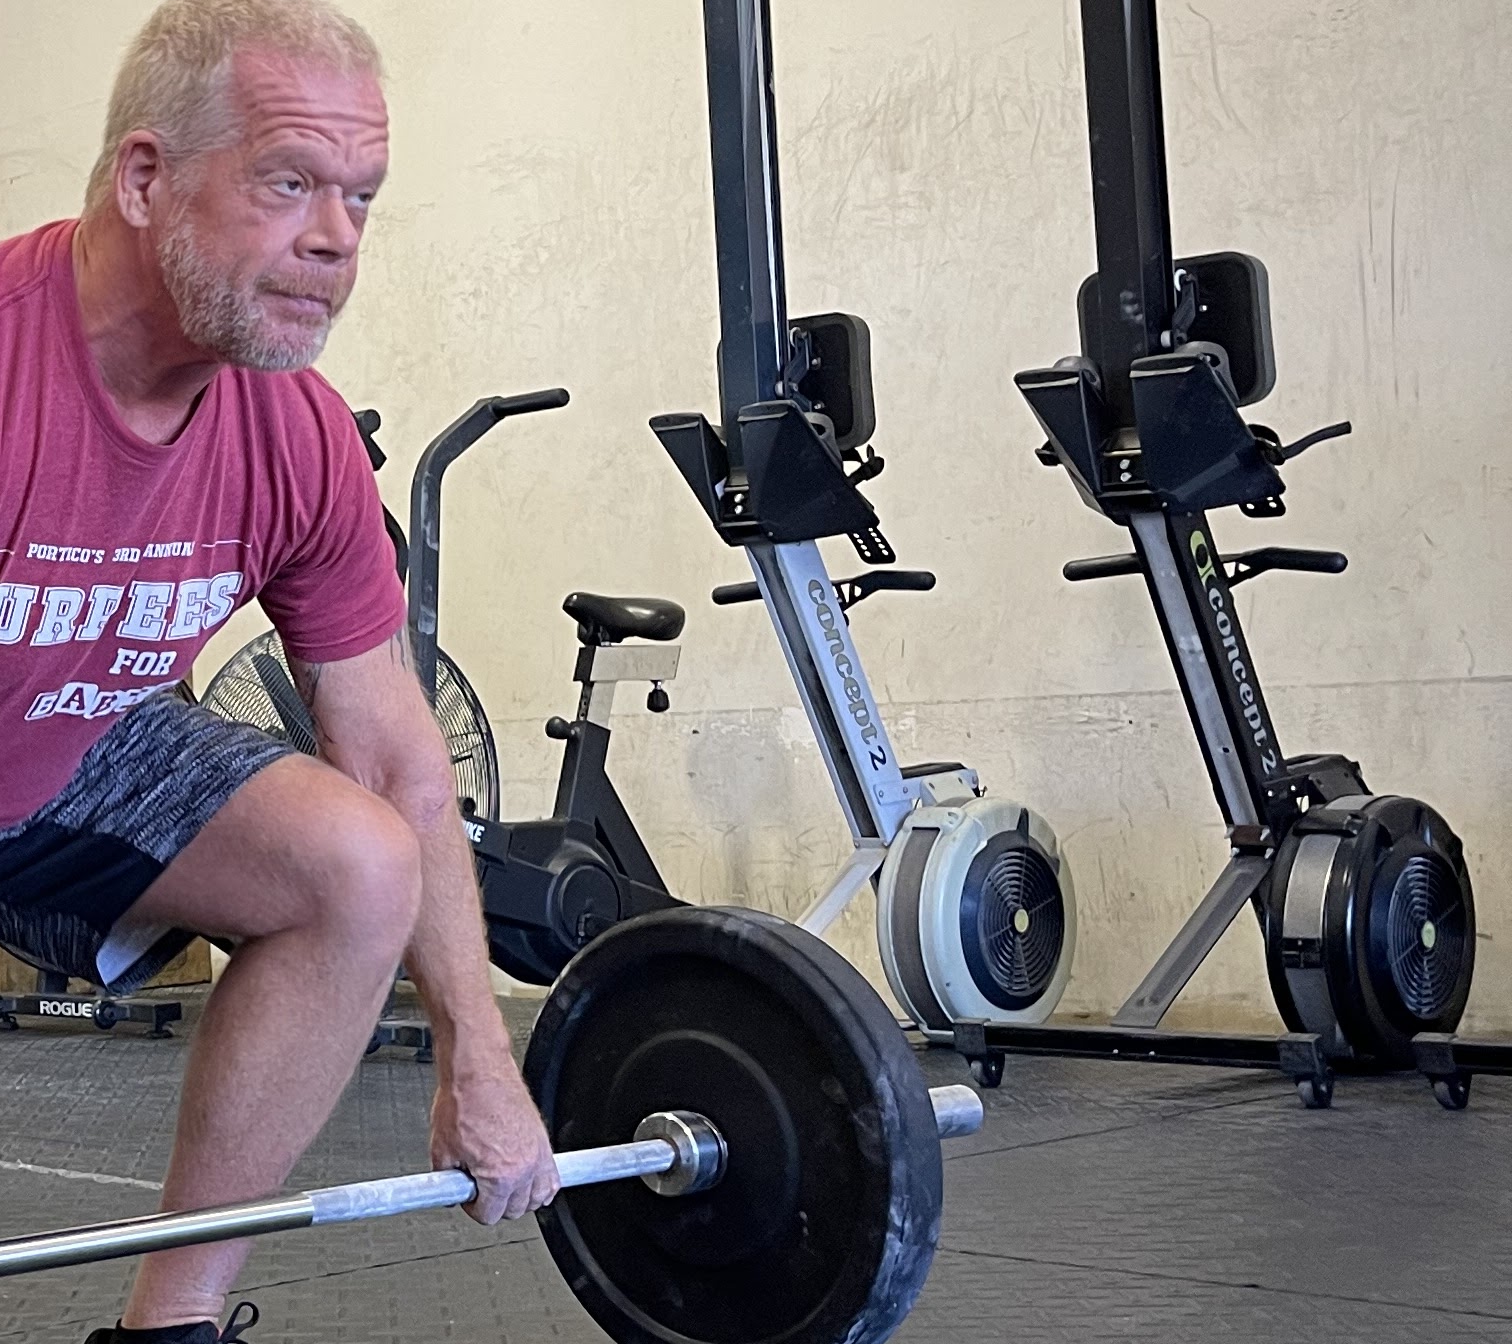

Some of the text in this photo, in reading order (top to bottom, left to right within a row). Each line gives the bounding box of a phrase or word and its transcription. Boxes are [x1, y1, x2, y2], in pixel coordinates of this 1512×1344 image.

[26, 542, 105, 564] PORTICO'S
[112, 548, 141, 563] 3RD
[108, 647, 177, 677] FOR
[39, 1000, 93, 1018] ROGUE
